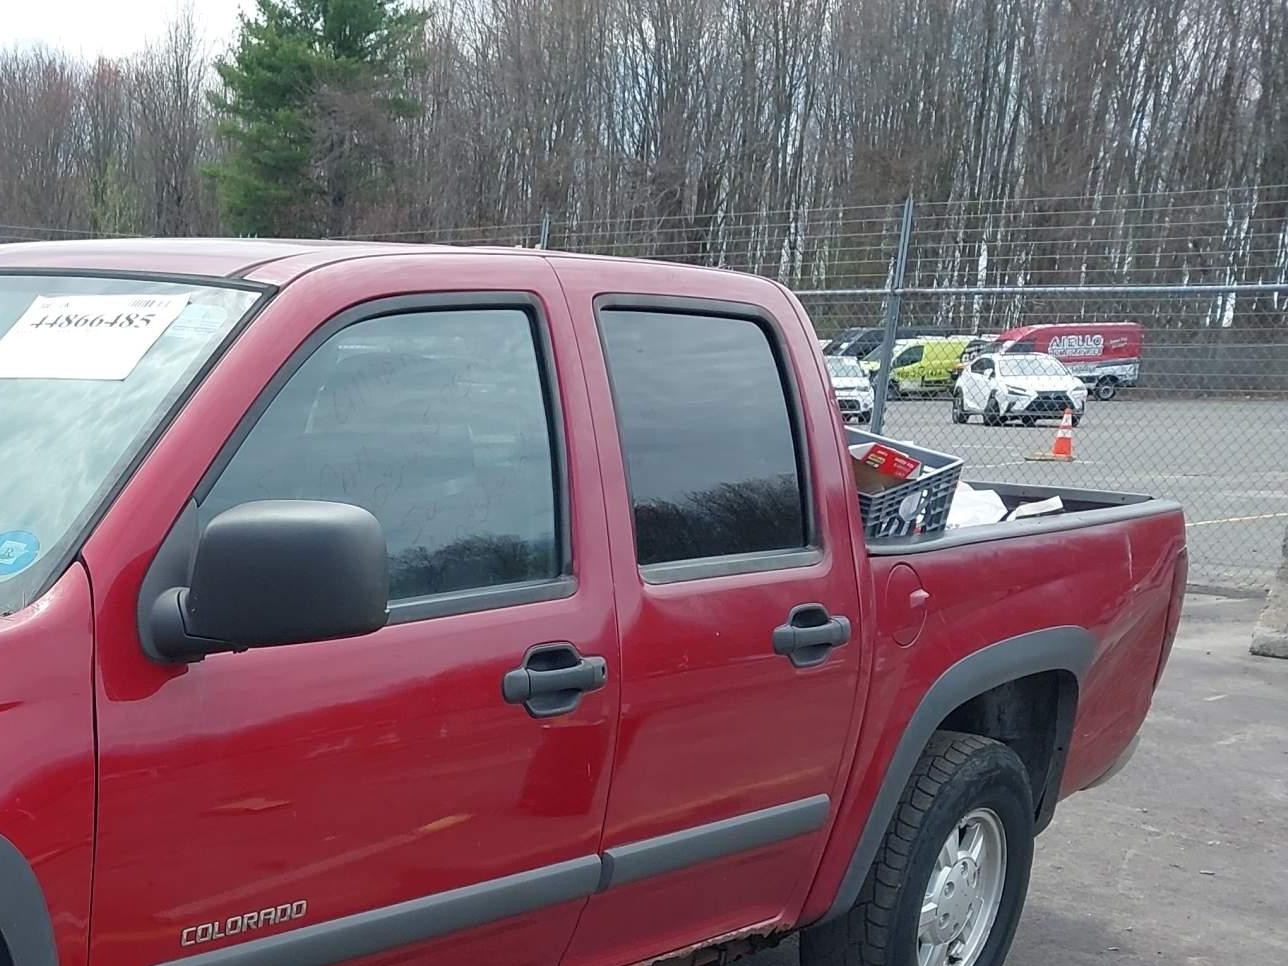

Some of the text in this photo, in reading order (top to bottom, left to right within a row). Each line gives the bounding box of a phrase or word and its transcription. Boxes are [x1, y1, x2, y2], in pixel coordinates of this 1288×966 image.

[30, 313, 156, 328] 44866485
[1050, 334, 1103, 348] AIELLO
[181, 899, 308, 947] COLORADO
